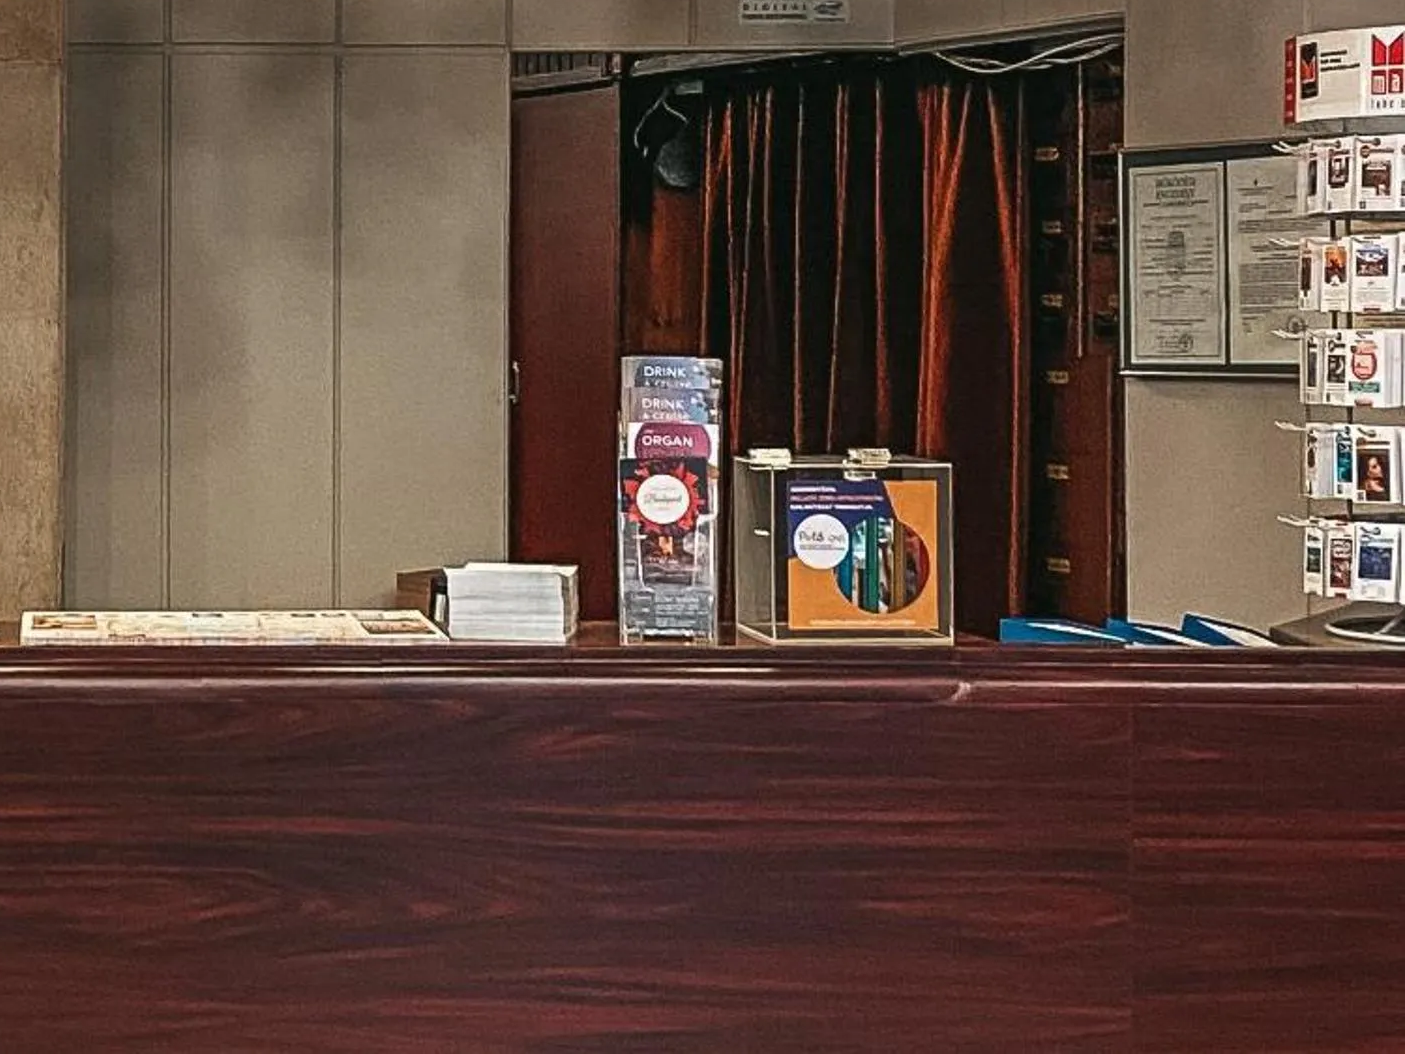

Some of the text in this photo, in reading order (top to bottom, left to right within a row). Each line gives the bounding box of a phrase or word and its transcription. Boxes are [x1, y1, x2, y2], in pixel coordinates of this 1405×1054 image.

[643, 365, 687, 378] DRINK
[641, 397, 685, 410] DRINK
[641, 435, 694, 448] ORGAN
